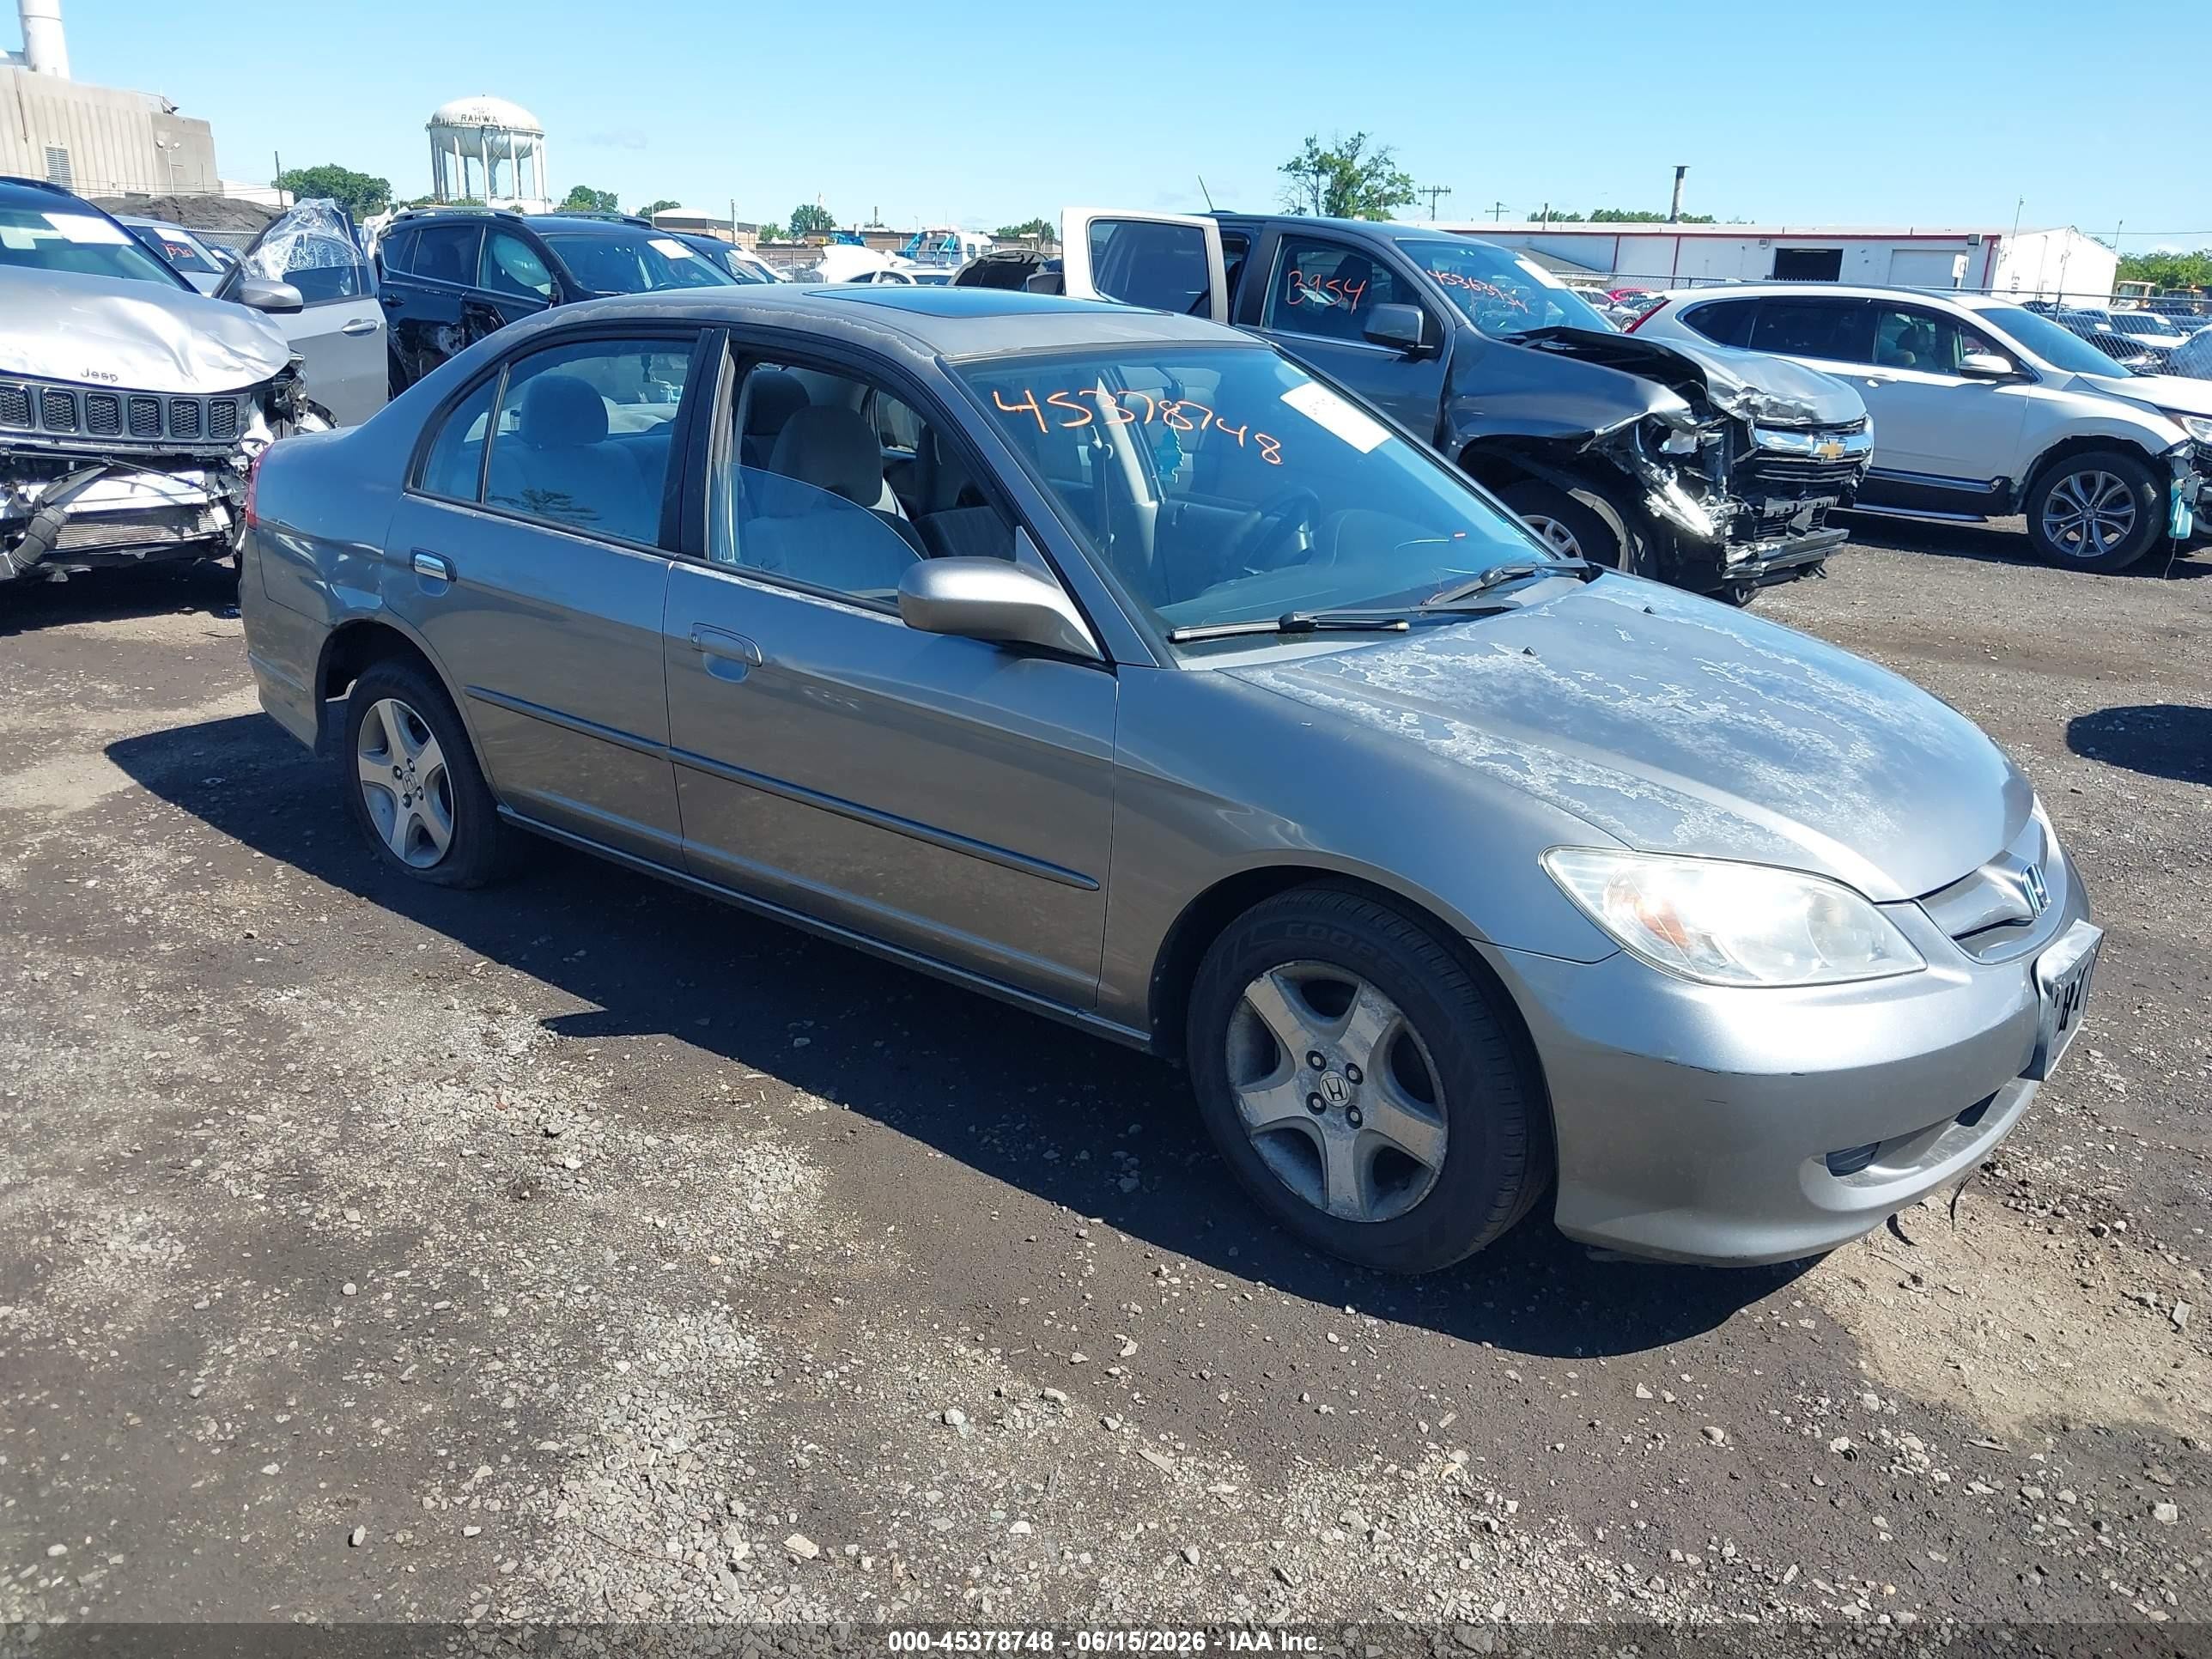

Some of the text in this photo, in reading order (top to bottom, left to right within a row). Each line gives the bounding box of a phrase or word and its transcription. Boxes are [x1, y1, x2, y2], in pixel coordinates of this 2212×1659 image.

[461, 114, 501, 123] RAHWA
[1286, 270, 1367, 315] B954
[80, 368, 118, 383] Jeep
[993, 389, 1285, 465] 45378748
